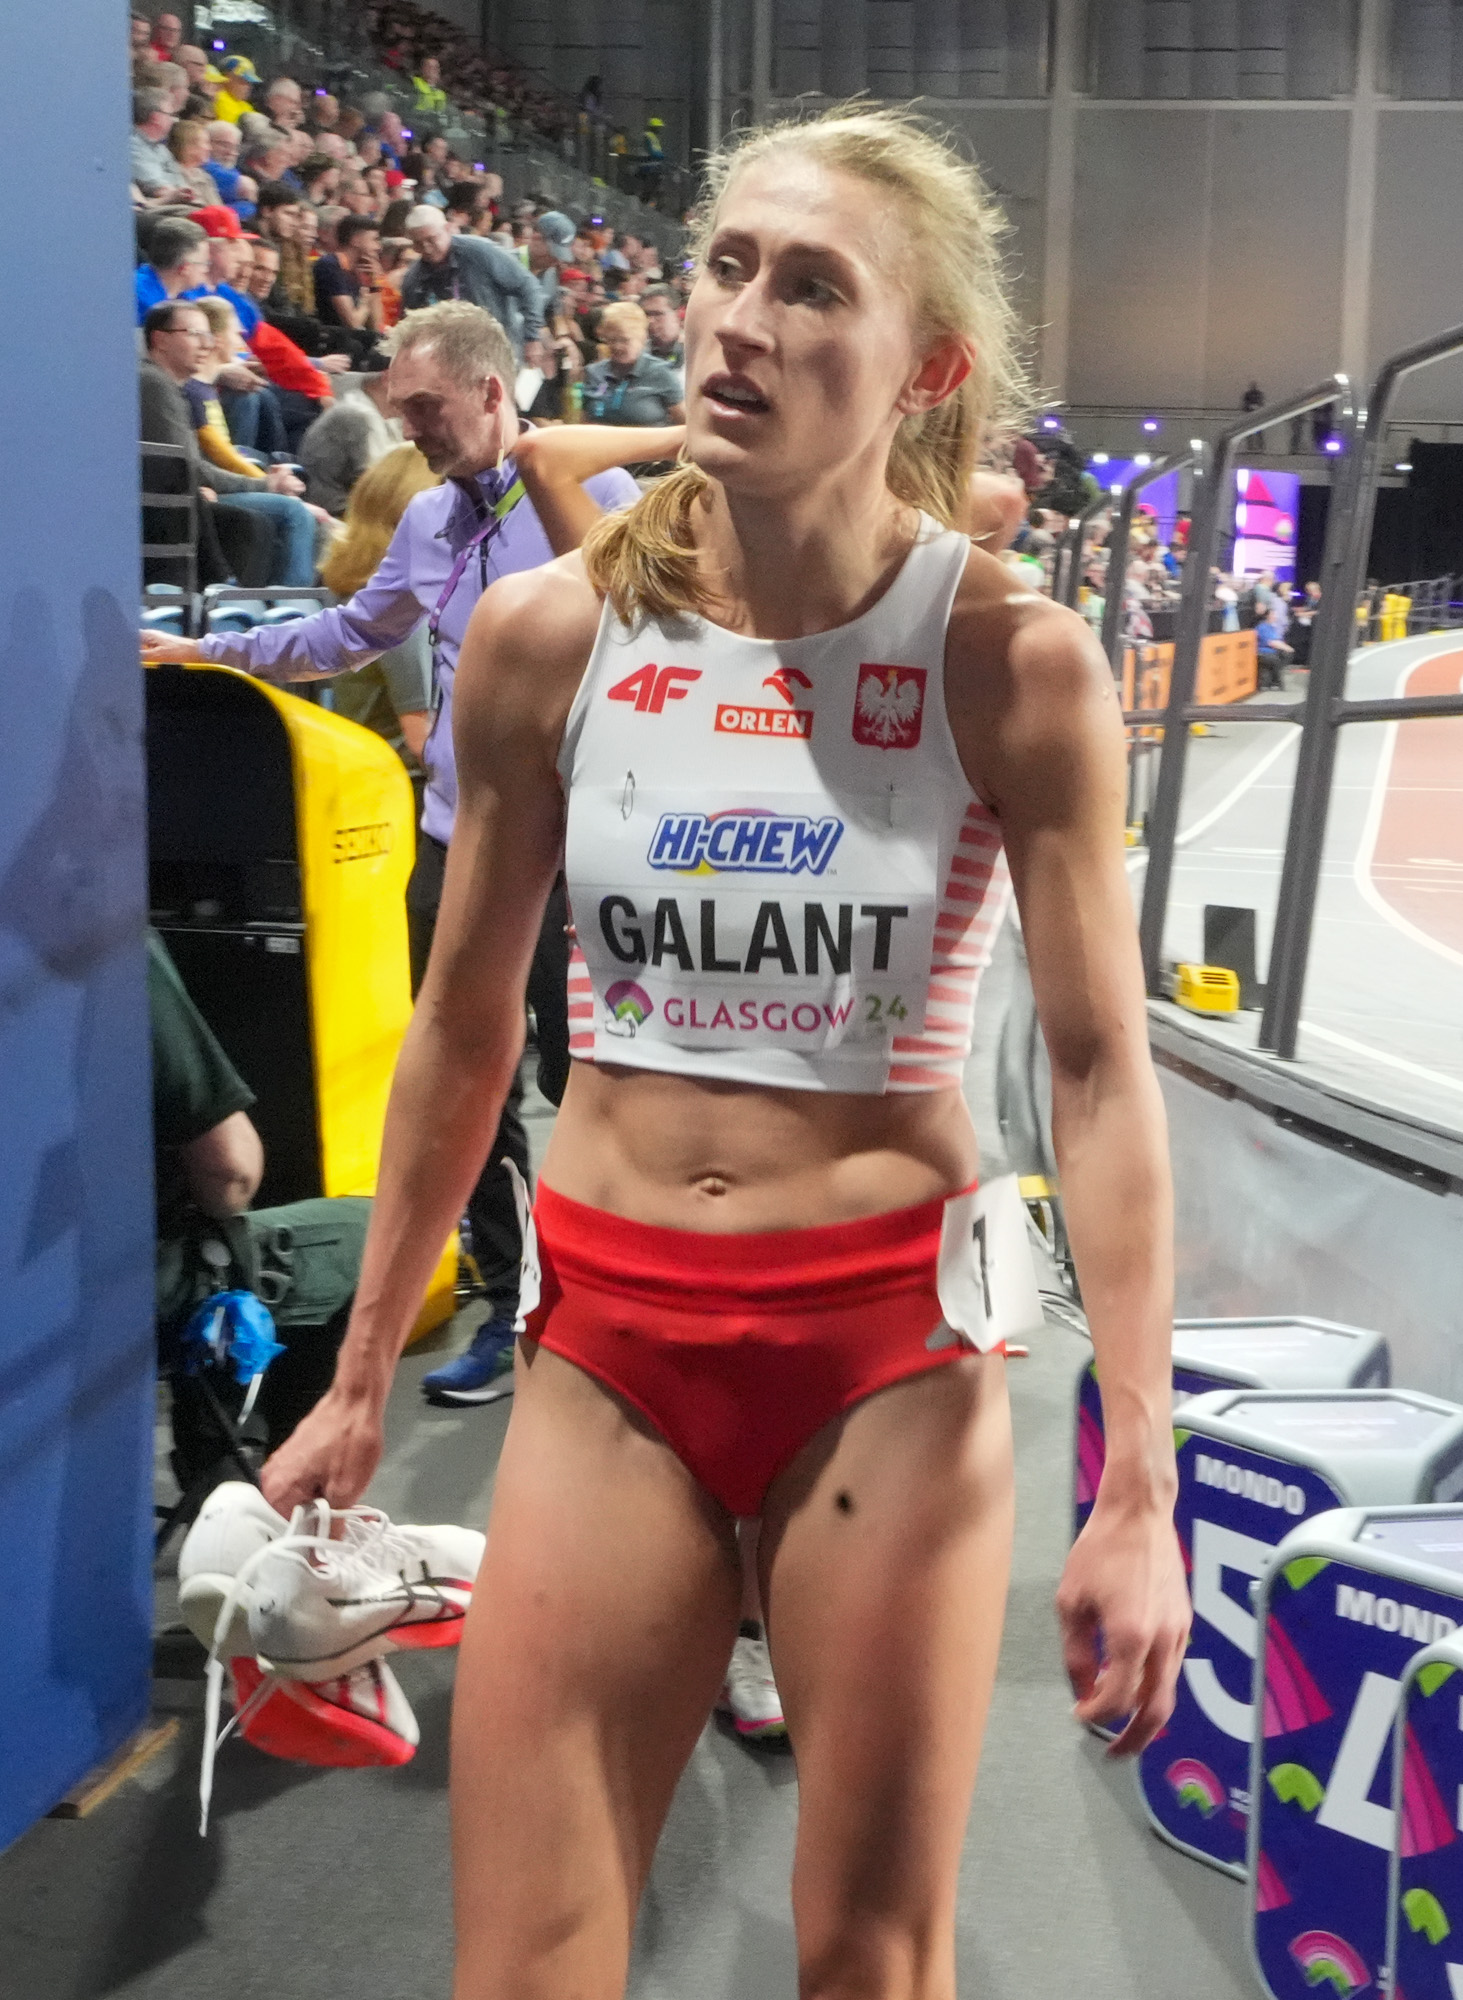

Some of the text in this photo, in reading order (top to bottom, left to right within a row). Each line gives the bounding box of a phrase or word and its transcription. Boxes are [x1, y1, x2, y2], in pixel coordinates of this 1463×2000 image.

[607, 663, 703, 714] 4F
[720, 708, 807, 734] ORLEN
[647, 813, 845, 876] HI-CHEW
[599, 894, 909, 975] GALANT
[664, 994, 908, 1033] GLASGOW 24
[973, 1214, 993, 1319] 1
[1195, 1453, 1306, 1516] MONDO
[1183, 1518, 1277, 1743] 5
[1336, 1584, 1458, 1645] MOND
